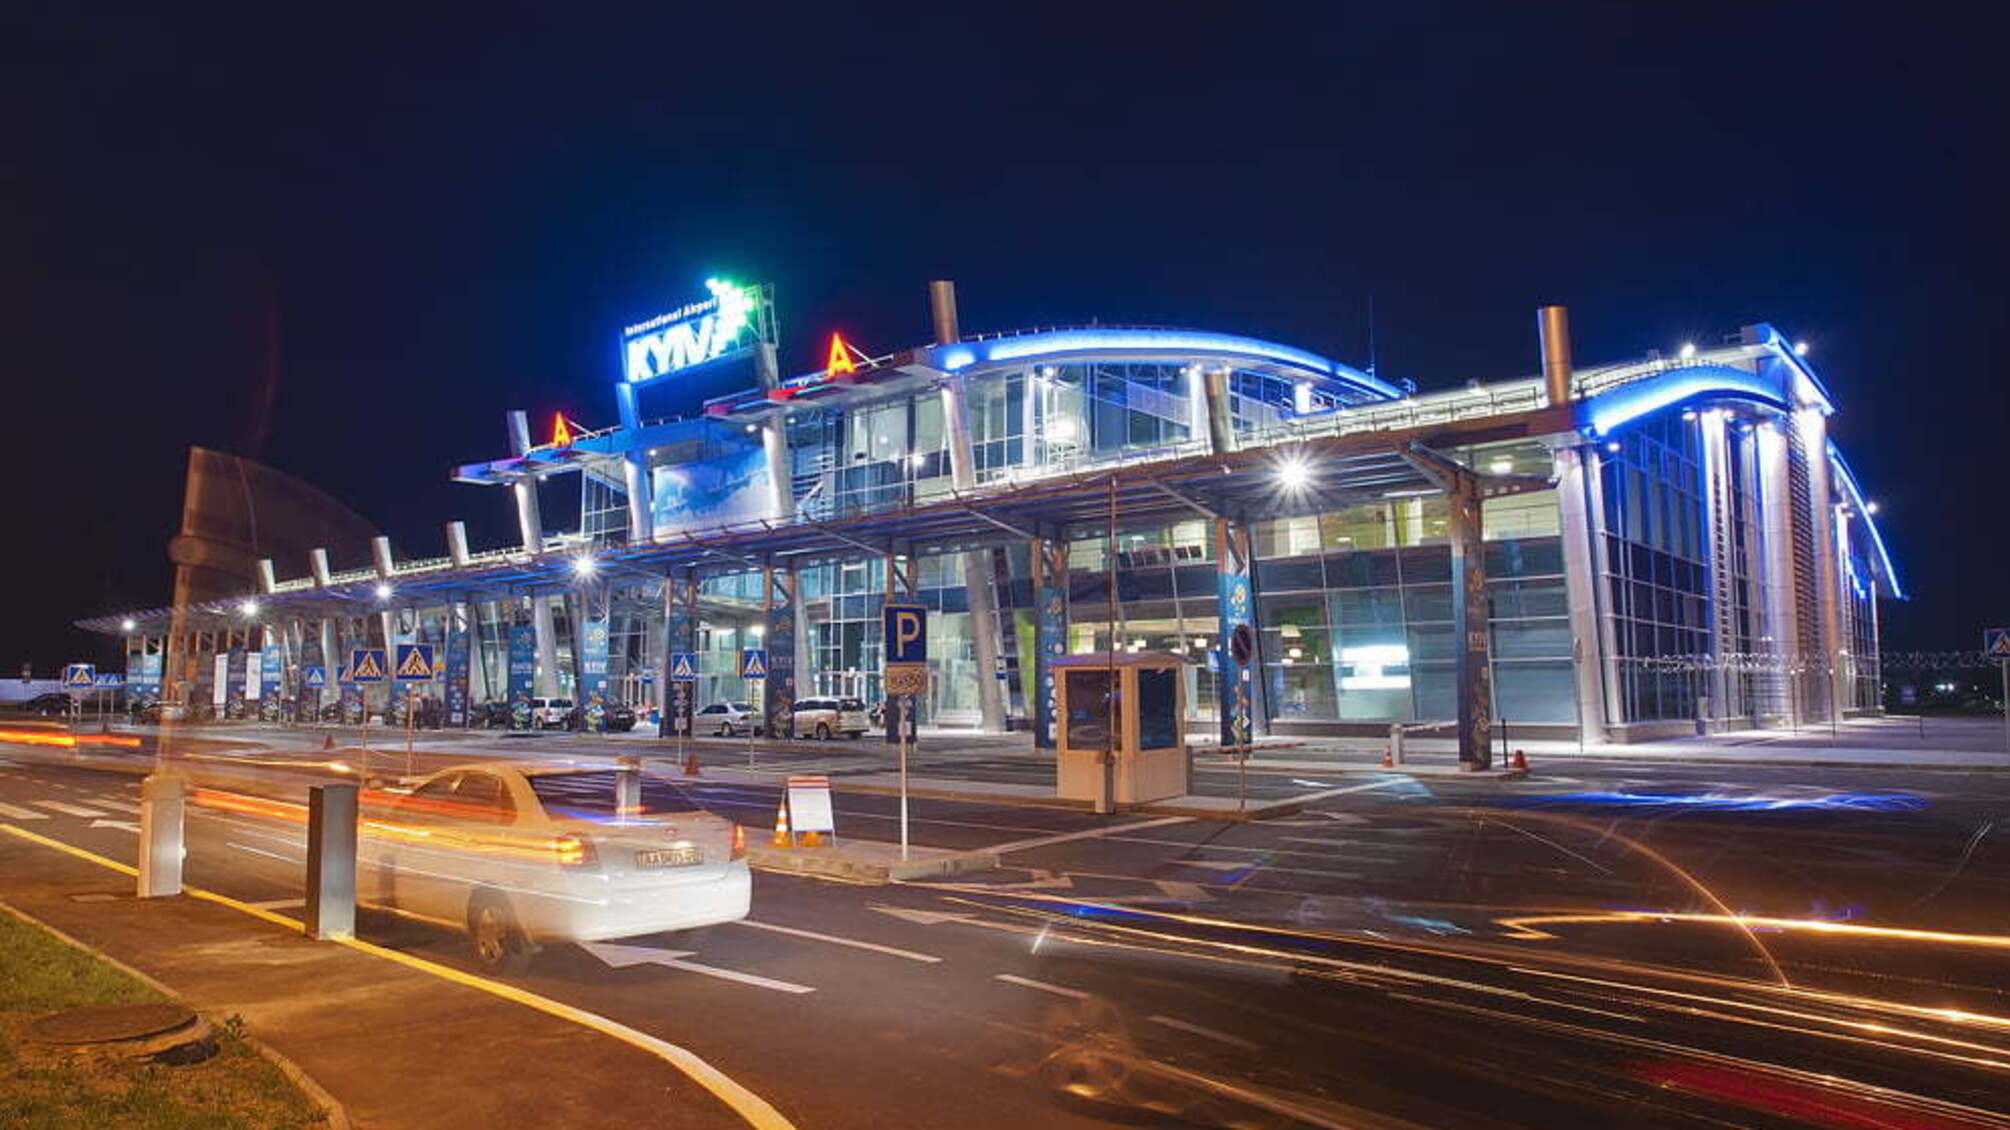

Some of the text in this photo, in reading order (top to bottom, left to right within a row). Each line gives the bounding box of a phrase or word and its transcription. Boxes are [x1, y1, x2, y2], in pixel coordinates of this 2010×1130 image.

[624, 297, 719, 336] International Airport
[627, 313, 717, 382] KYIV
[828, 332, 855, 376] A
[553, 411, 571, 447] A
[897, 612, 920, 657] P
